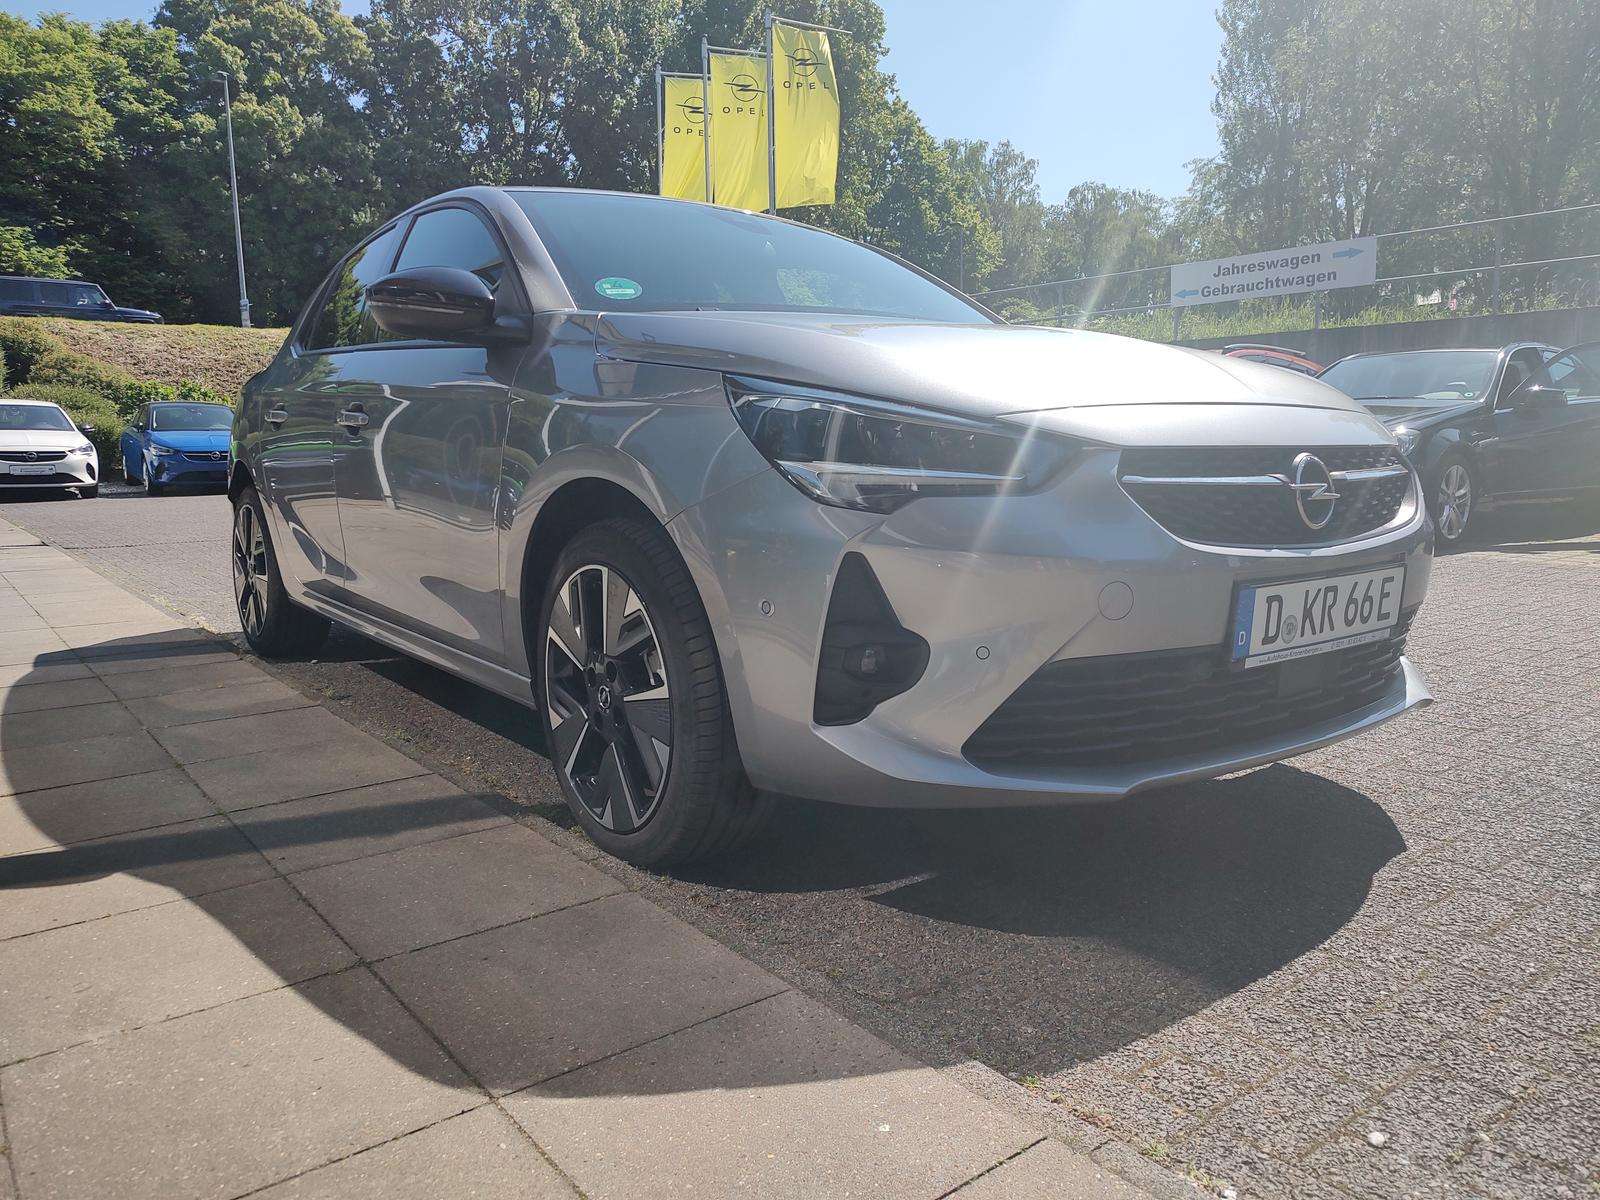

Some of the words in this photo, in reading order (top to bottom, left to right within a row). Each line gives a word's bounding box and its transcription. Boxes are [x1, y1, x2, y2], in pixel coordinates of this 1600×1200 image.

[783, 80, 830, 90] OPEL
[673, 126, 711, 138] OPE
[1212, 251, 1322, 279] Jahreswagen
[1200, 270, 1338, 298] Gebrauchtwagen
[1261, 594, 1284, 646] D
[1300, 585, 1339, 638] KR
[1344, 575, 1395, 628] 66E
[1238, 631, 1246, 646] D
